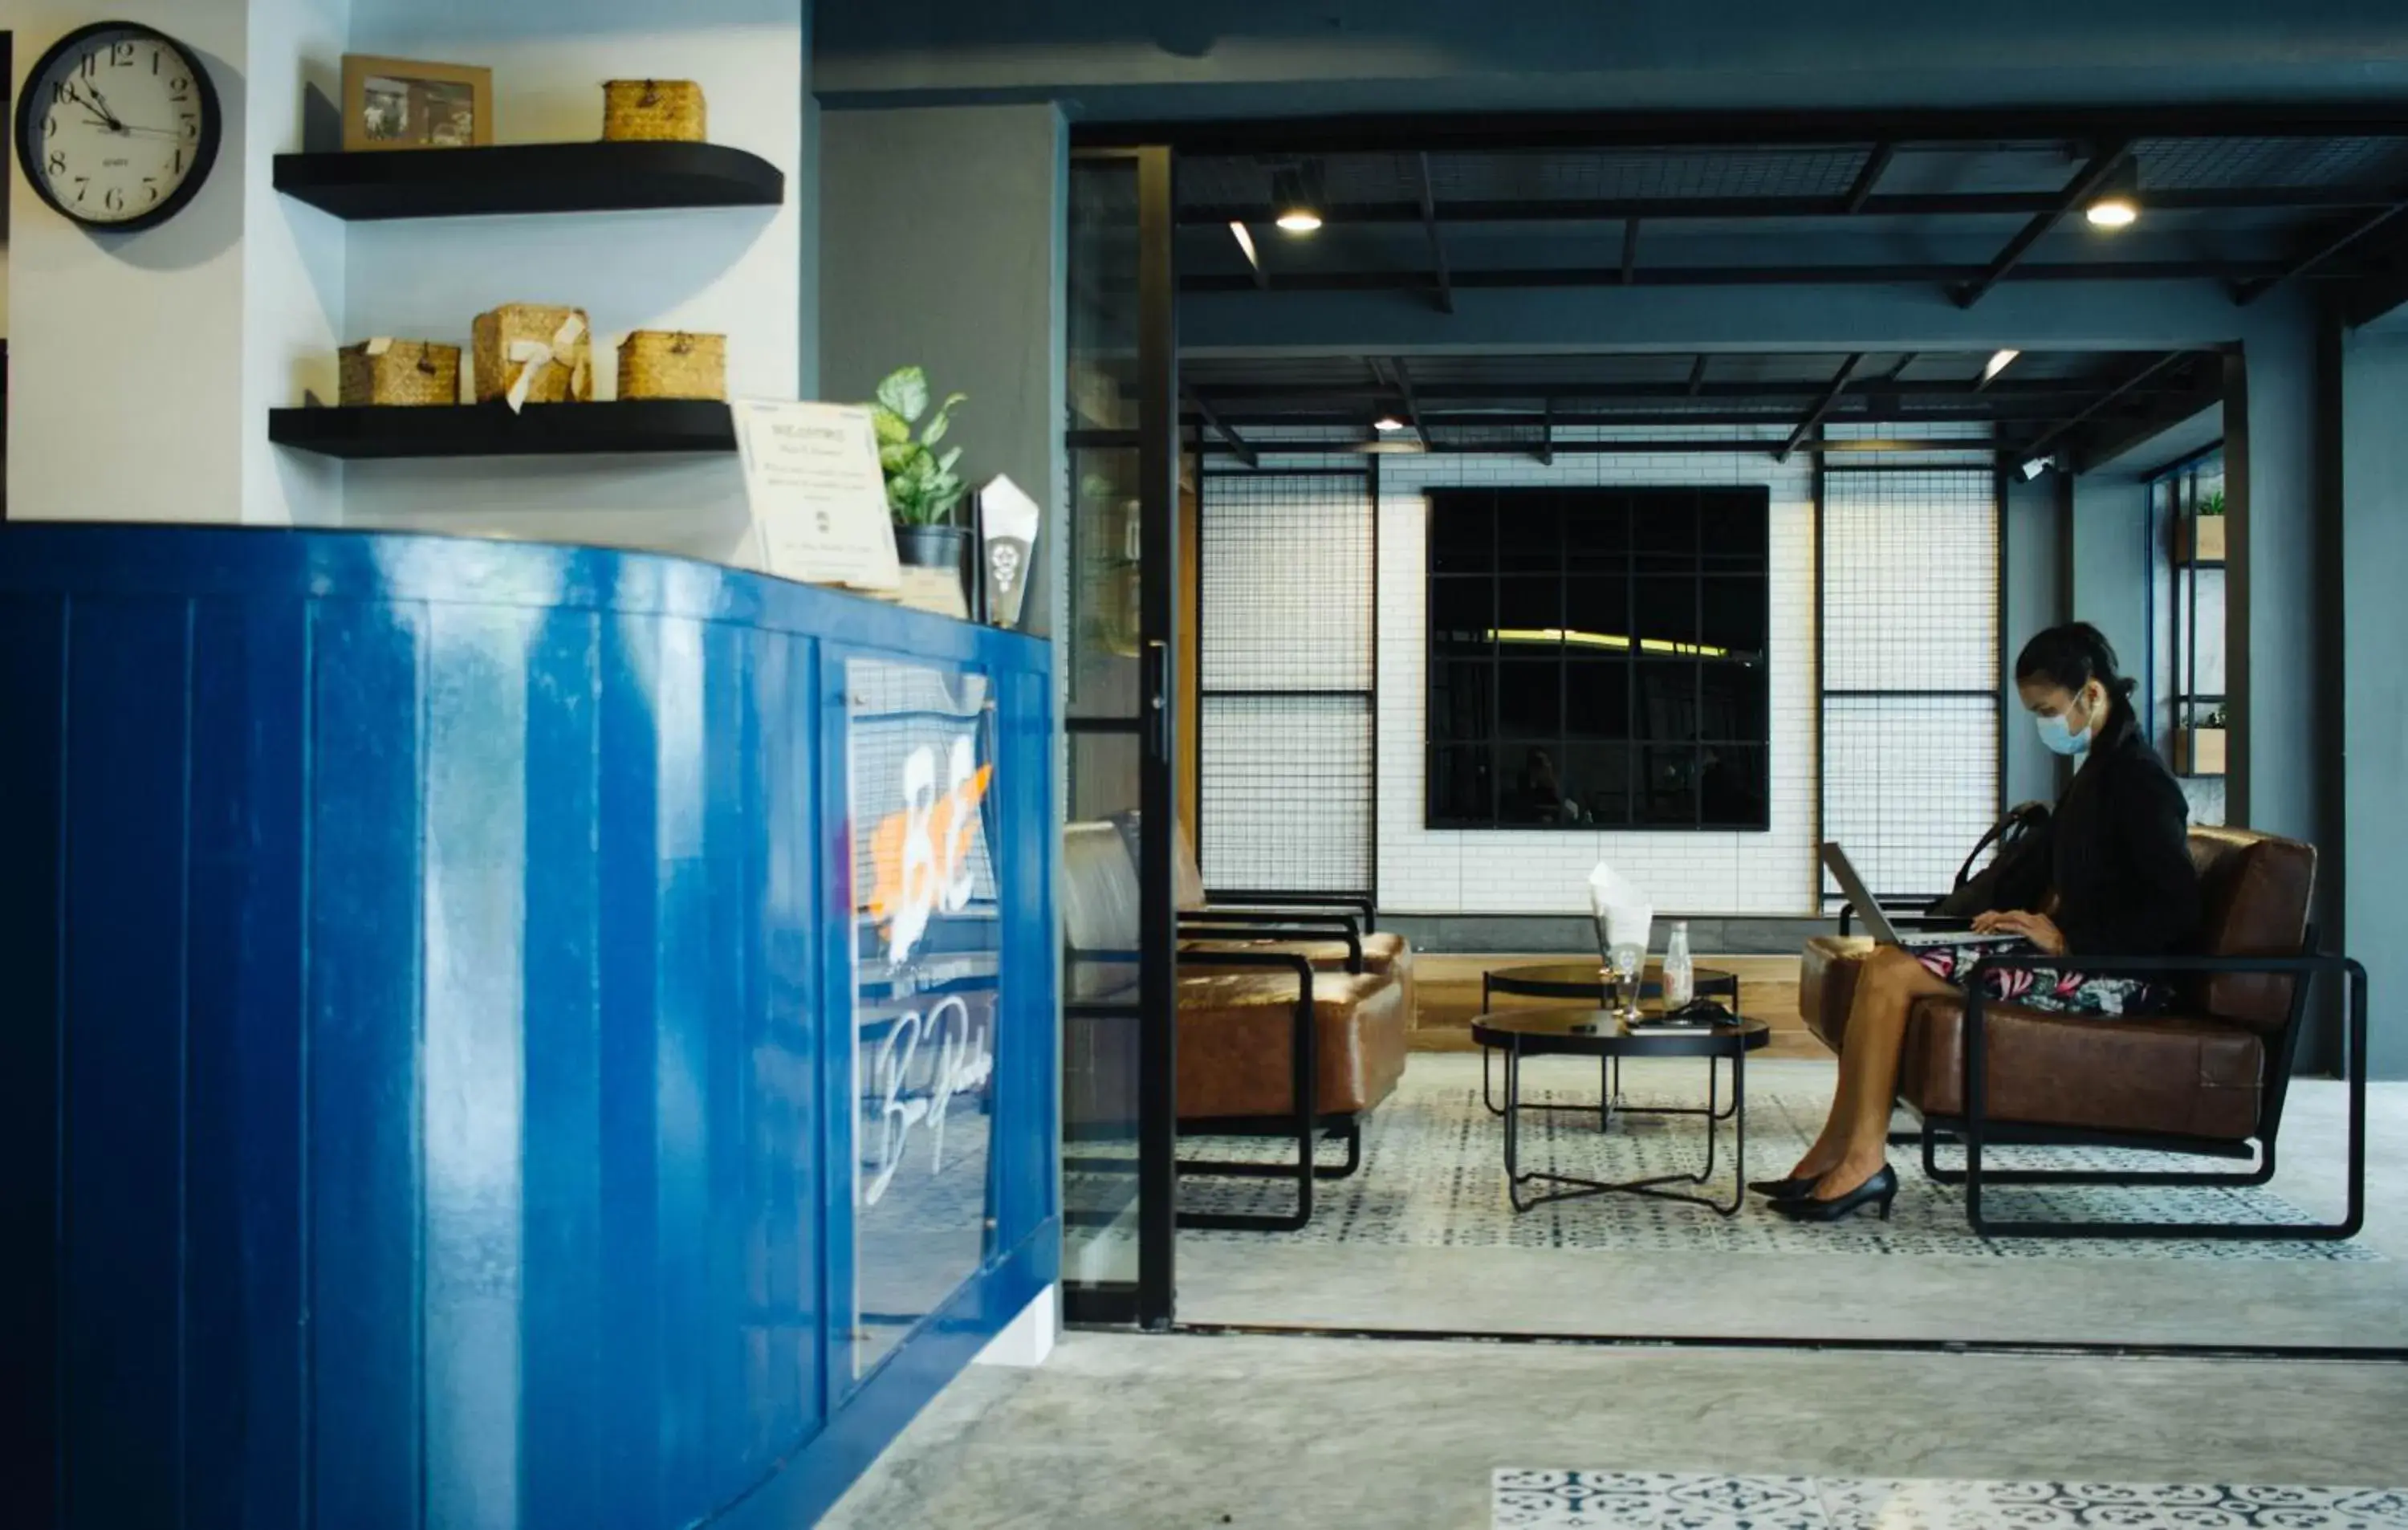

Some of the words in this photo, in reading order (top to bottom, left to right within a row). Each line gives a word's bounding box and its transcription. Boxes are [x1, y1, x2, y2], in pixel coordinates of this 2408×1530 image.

[81, 53, 95, 77] 11
[111, 43, 133, 67] 12
[153, 51, 159, 75] 1
[52, 81, 75, 104] 10
[170, 78, 188, 102] 2
[40, 116, 57, 140] 9
[49, 151, 66, 177] 8
[74, 176, 91, 202] 7
[105, 187, 124, 212] 6
